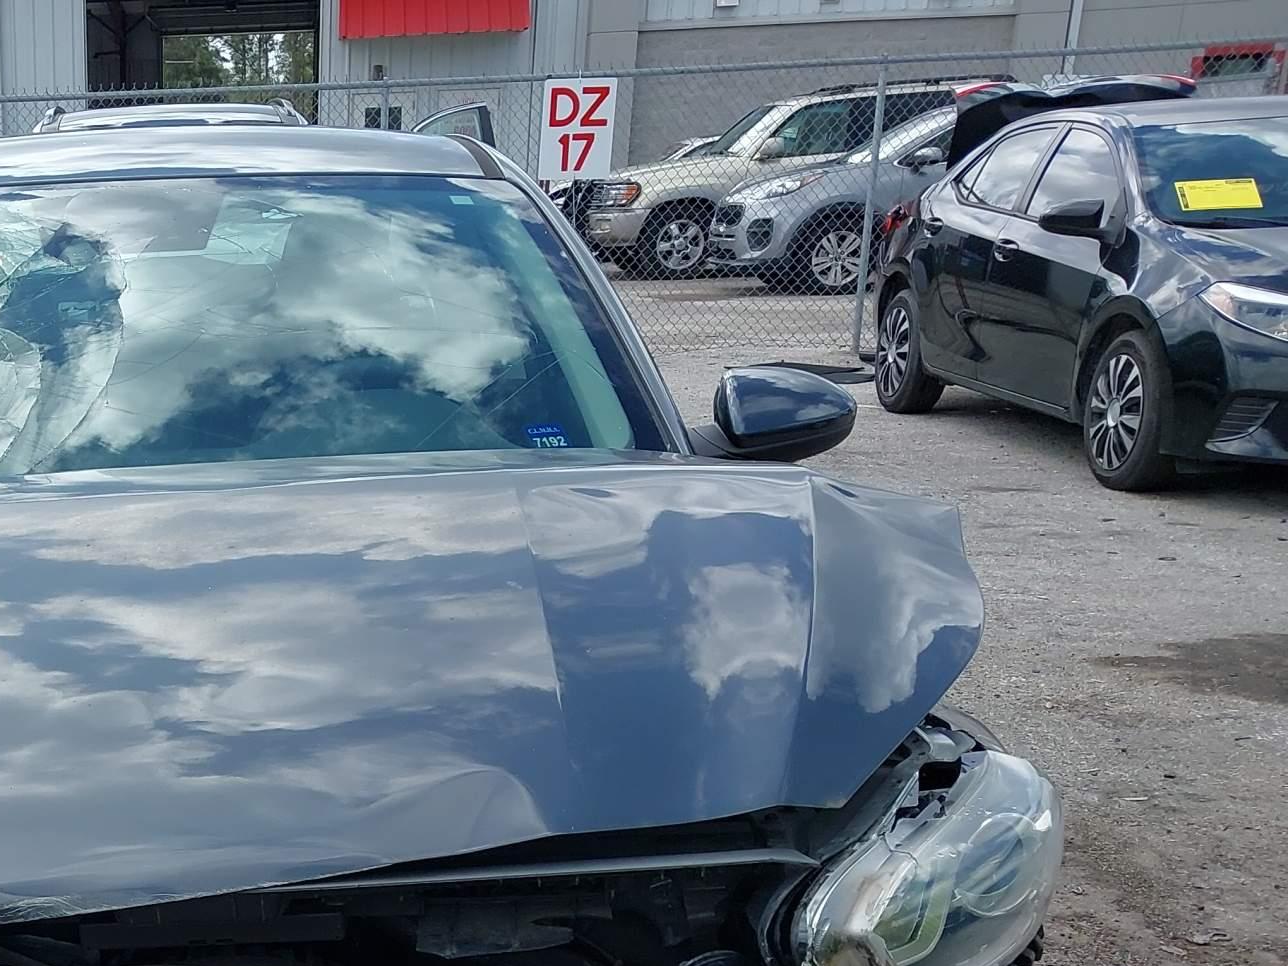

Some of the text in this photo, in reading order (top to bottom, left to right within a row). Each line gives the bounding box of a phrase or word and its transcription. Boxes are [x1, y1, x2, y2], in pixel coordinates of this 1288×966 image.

[549, 86, 610, 127] DZ
[558, 133, 595, 171] 17
[532, 435, 568, 448] 7192
